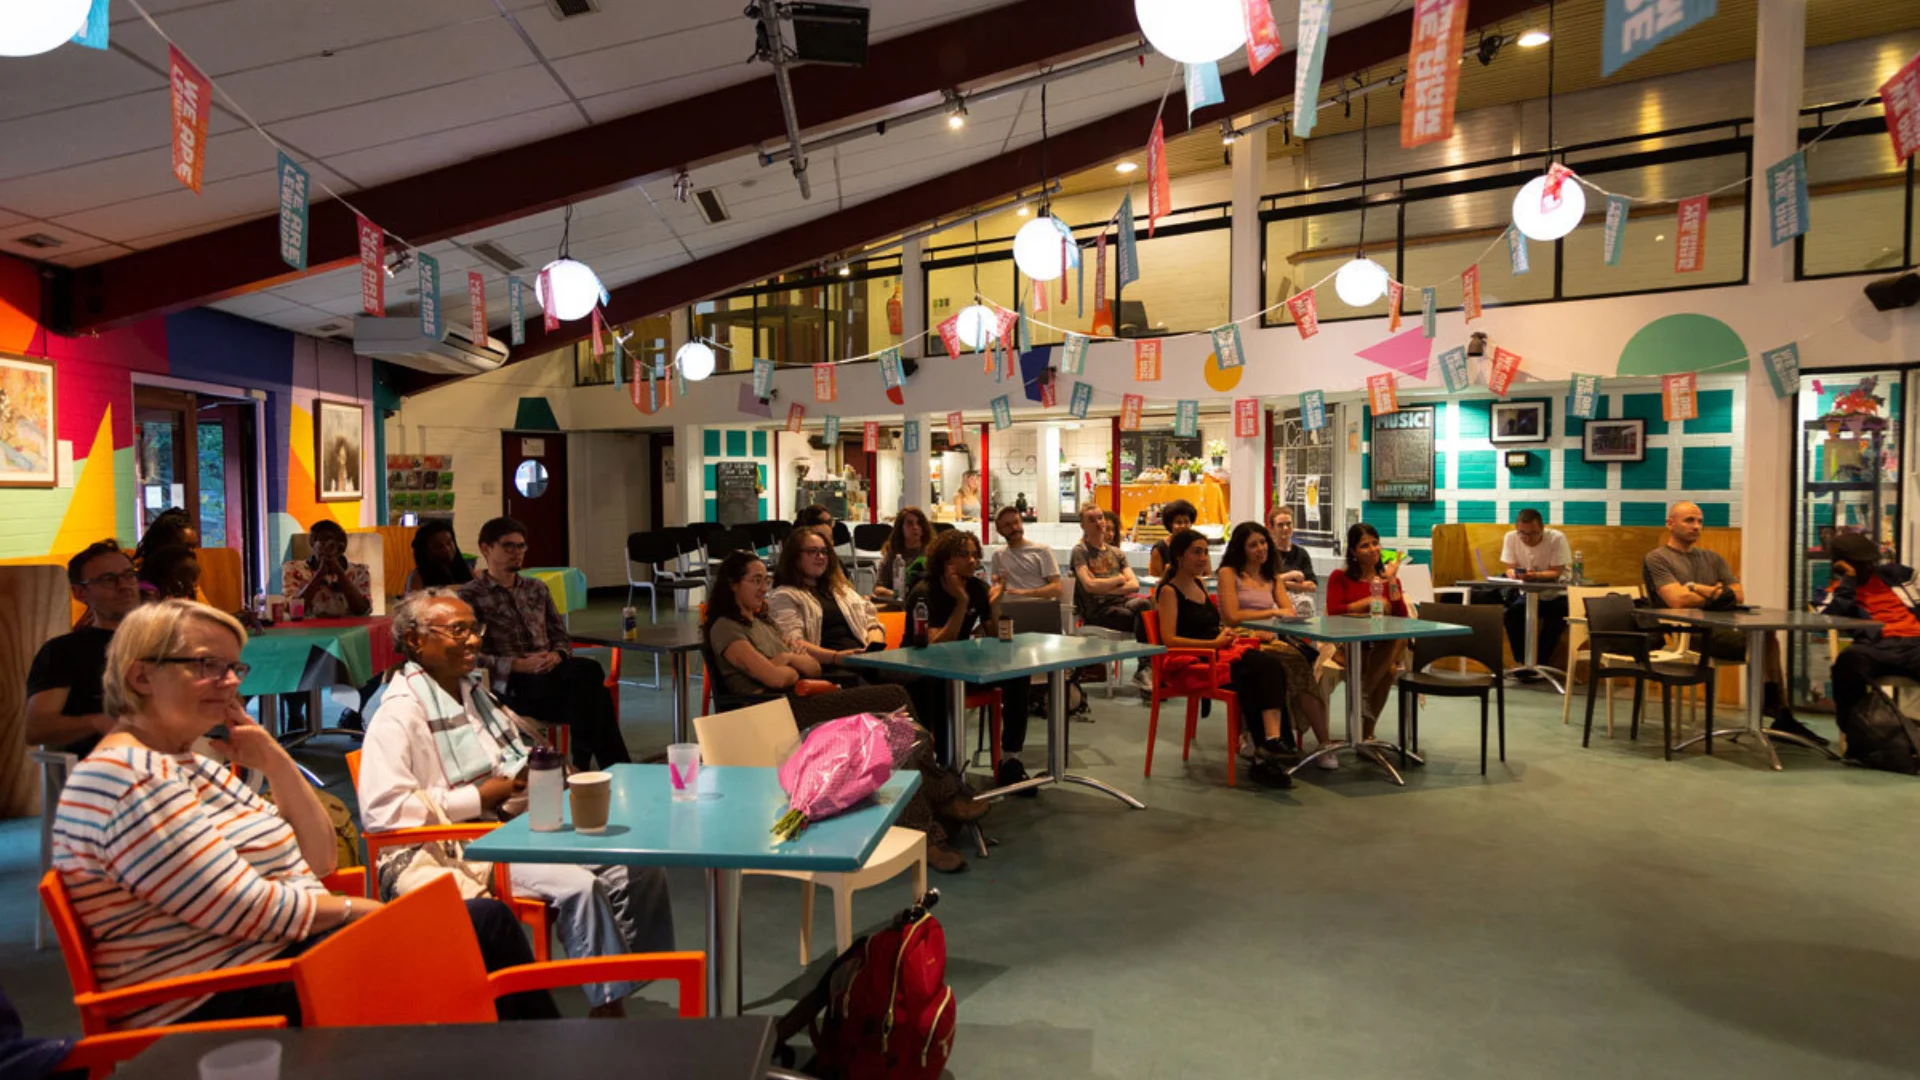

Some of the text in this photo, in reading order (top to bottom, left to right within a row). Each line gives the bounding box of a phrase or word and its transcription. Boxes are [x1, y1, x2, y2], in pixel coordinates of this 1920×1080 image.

[176, 76, 199, 185] WE ARE
[280, 164, 296, 261] LEWISHAM
[289, 173, 305, 264] WE ARE
[367, 231, 379, 311] WE ARE
